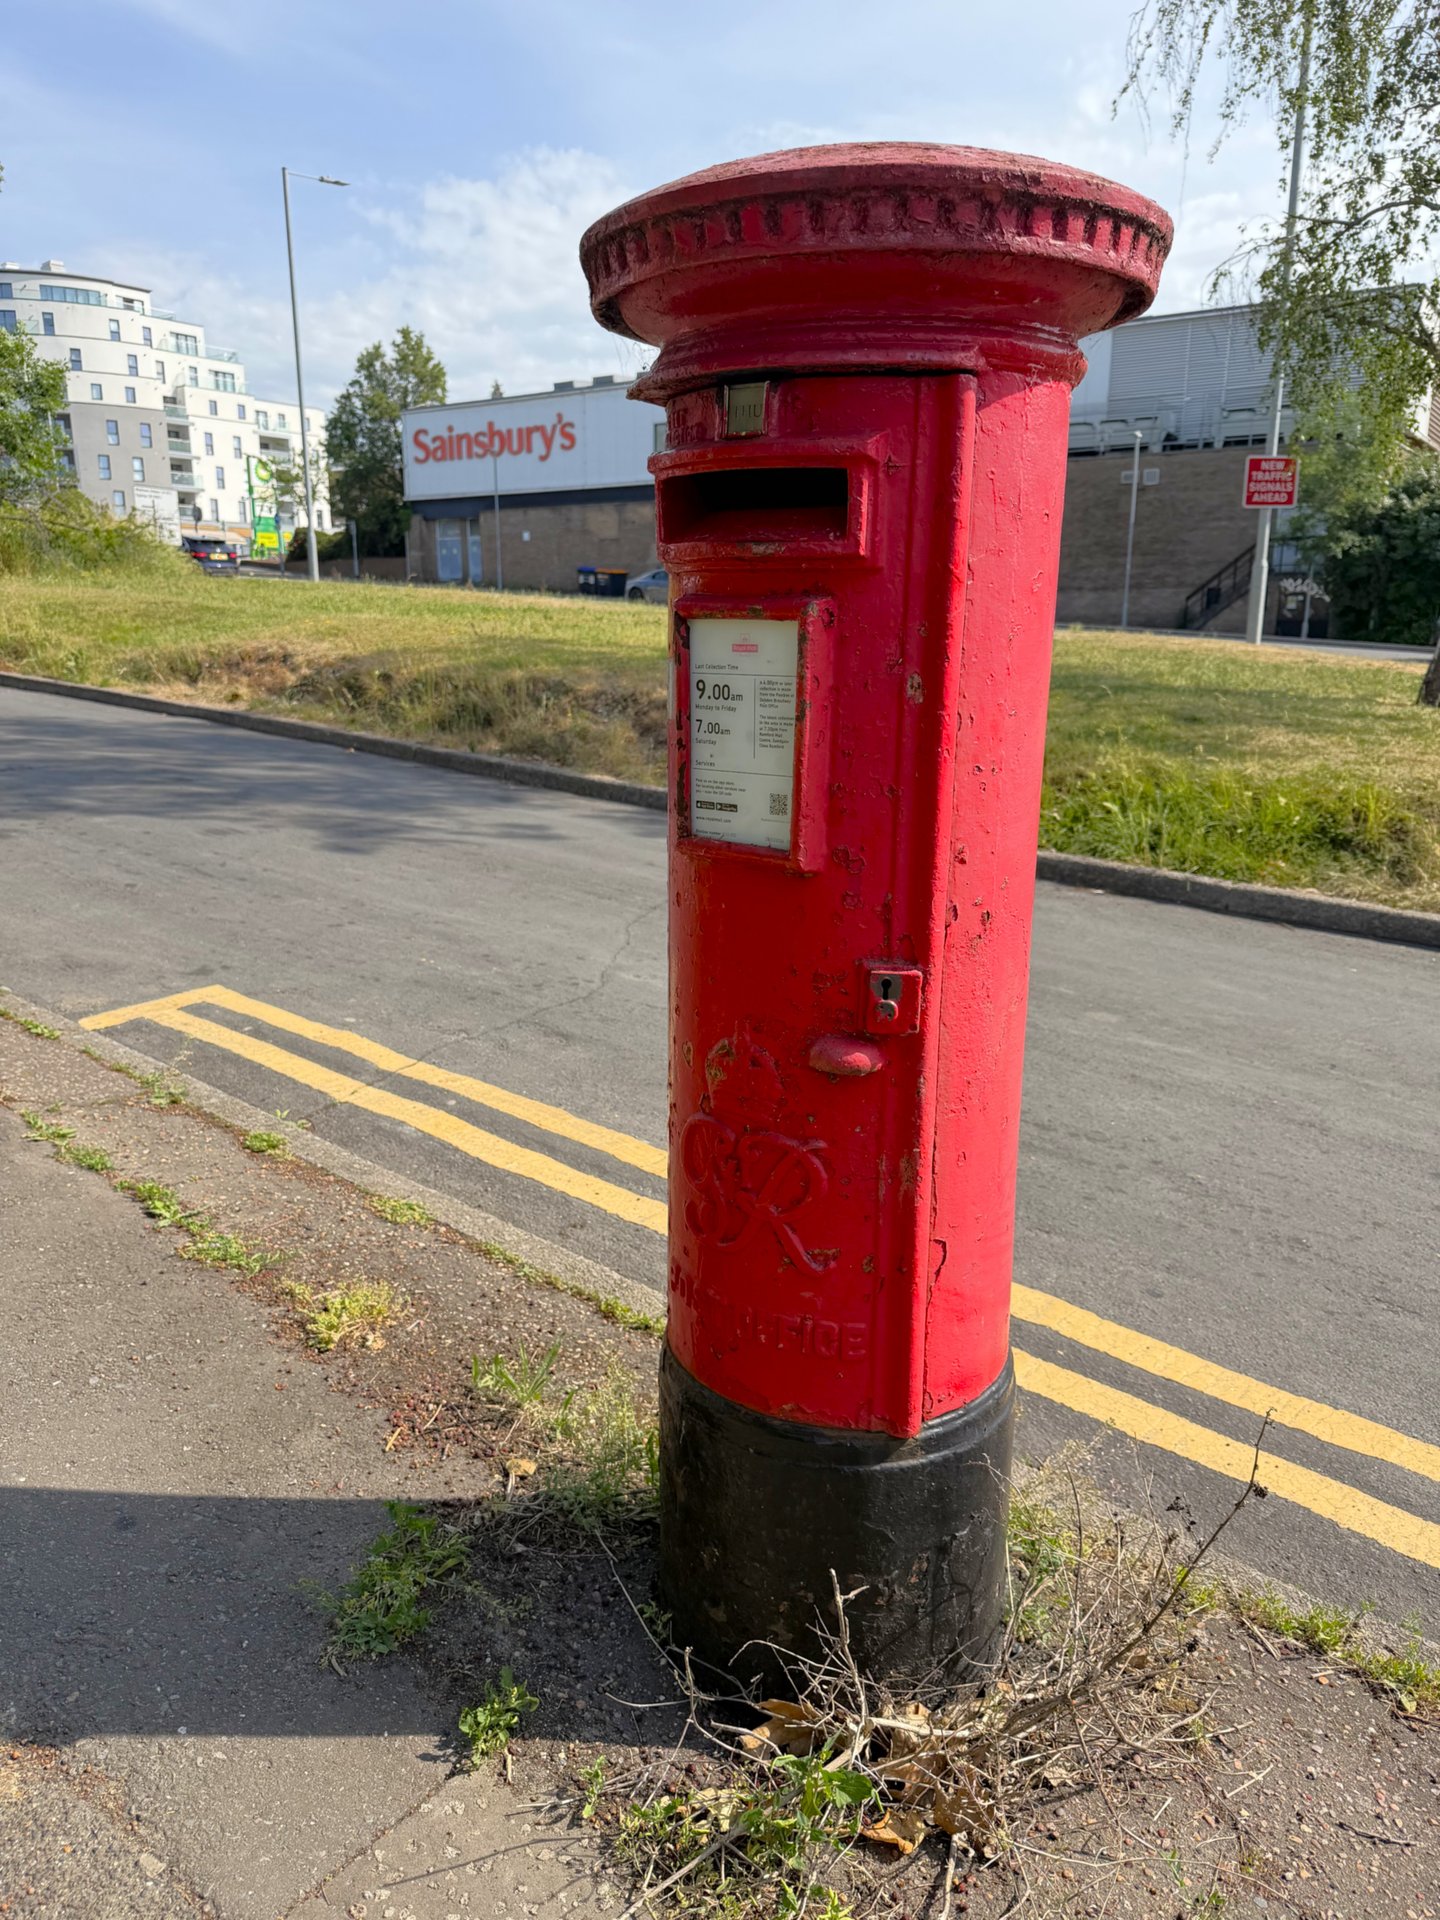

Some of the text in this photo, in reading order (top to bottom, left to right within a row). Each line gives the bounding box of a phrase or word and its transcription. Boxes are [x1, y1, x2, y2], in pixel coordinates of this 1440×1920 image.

[412, 411, 577, 464] Sainsbury's
[1261, 460, 1286, 471] NEW
[1251, 470, 1292, 481] TRAFFIC
[1249, 481, 1293, 492] SIGNALS
[1251, 492, 1289, 503] AHEAD
[695, 679, 743, 702] 9.00am
[721, 704, 737, 713] Friday
[695, 719, 731, 735] 7.00am
[695, 737, 717, 745] Saturday
[695, 759, 716, 767] Services
